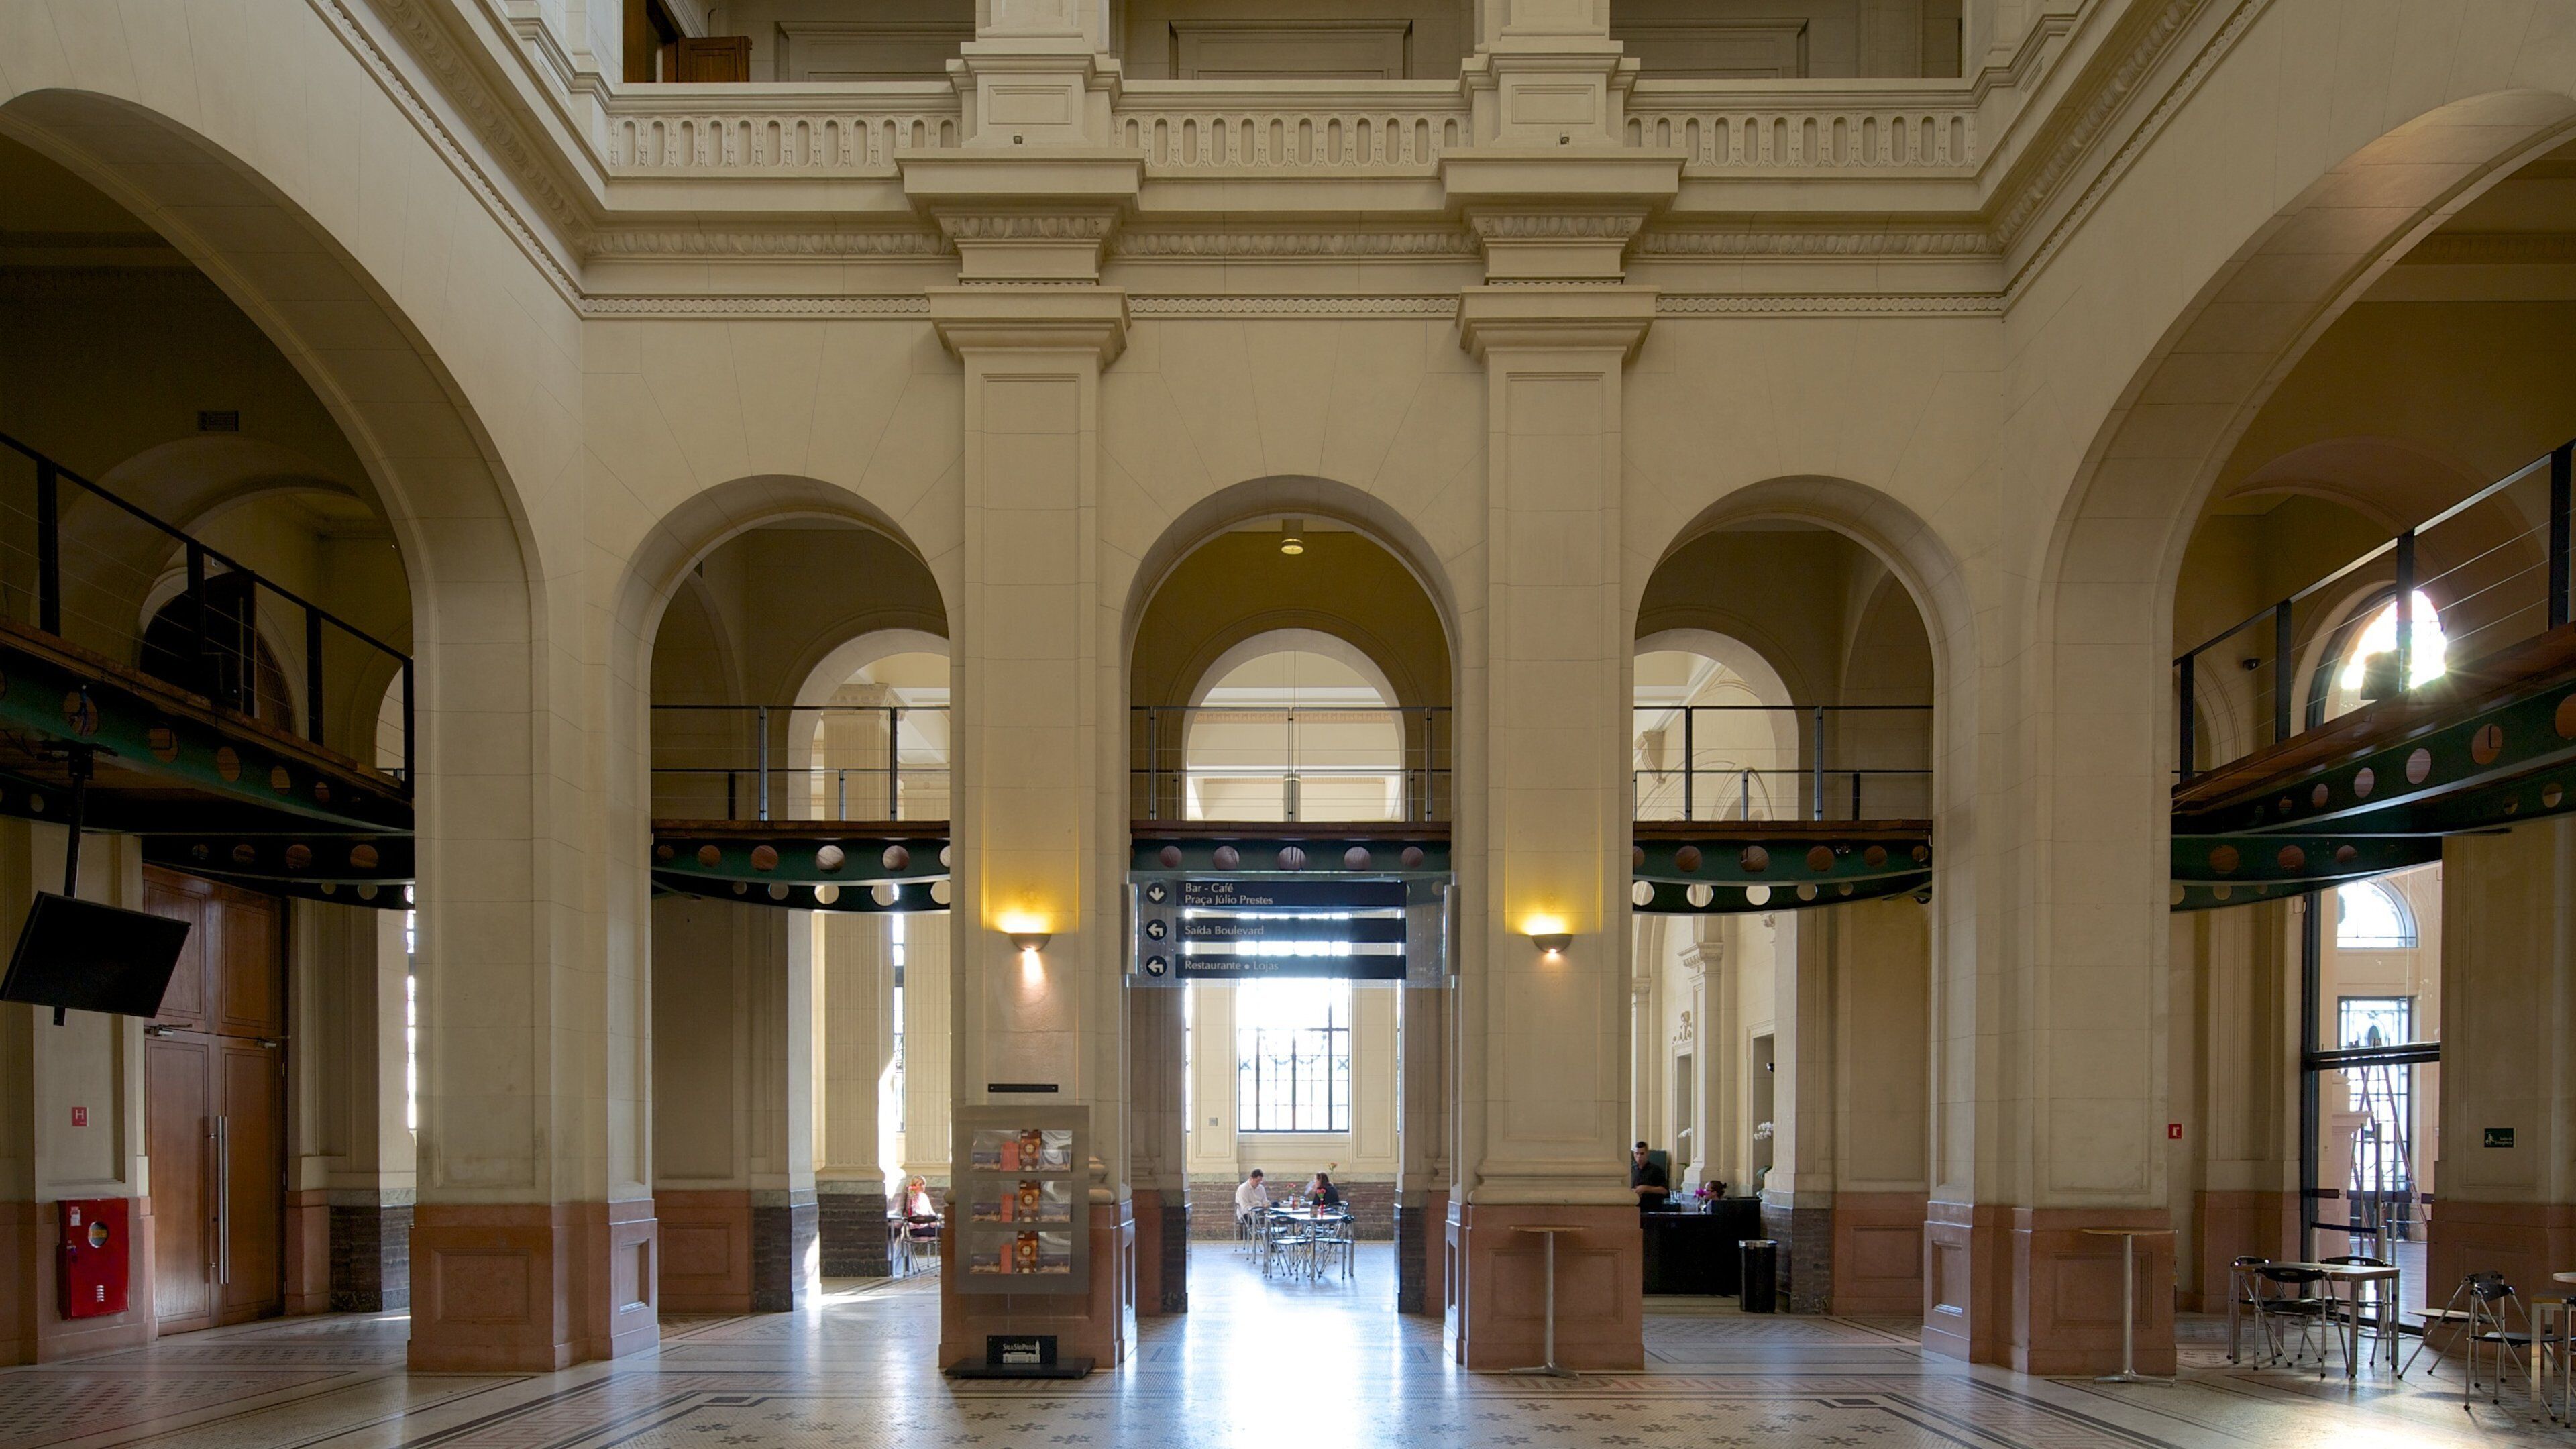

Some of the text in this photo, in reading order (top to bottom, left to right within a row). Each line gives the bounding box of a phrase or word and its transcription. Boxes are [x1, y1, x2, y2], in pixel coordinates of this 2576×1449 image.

[1185, 883, 1201, 892] Bar
[1211, 883, 1234, 893] Café
[1185, 894, 1273, 906] Praça Júlio Prestes
[1185, 925, 1264, 935] Saída Boulevard
[1185, 961, 1279, 973] Restaurante Lojas
[75, 1109, 84, 1120] H
